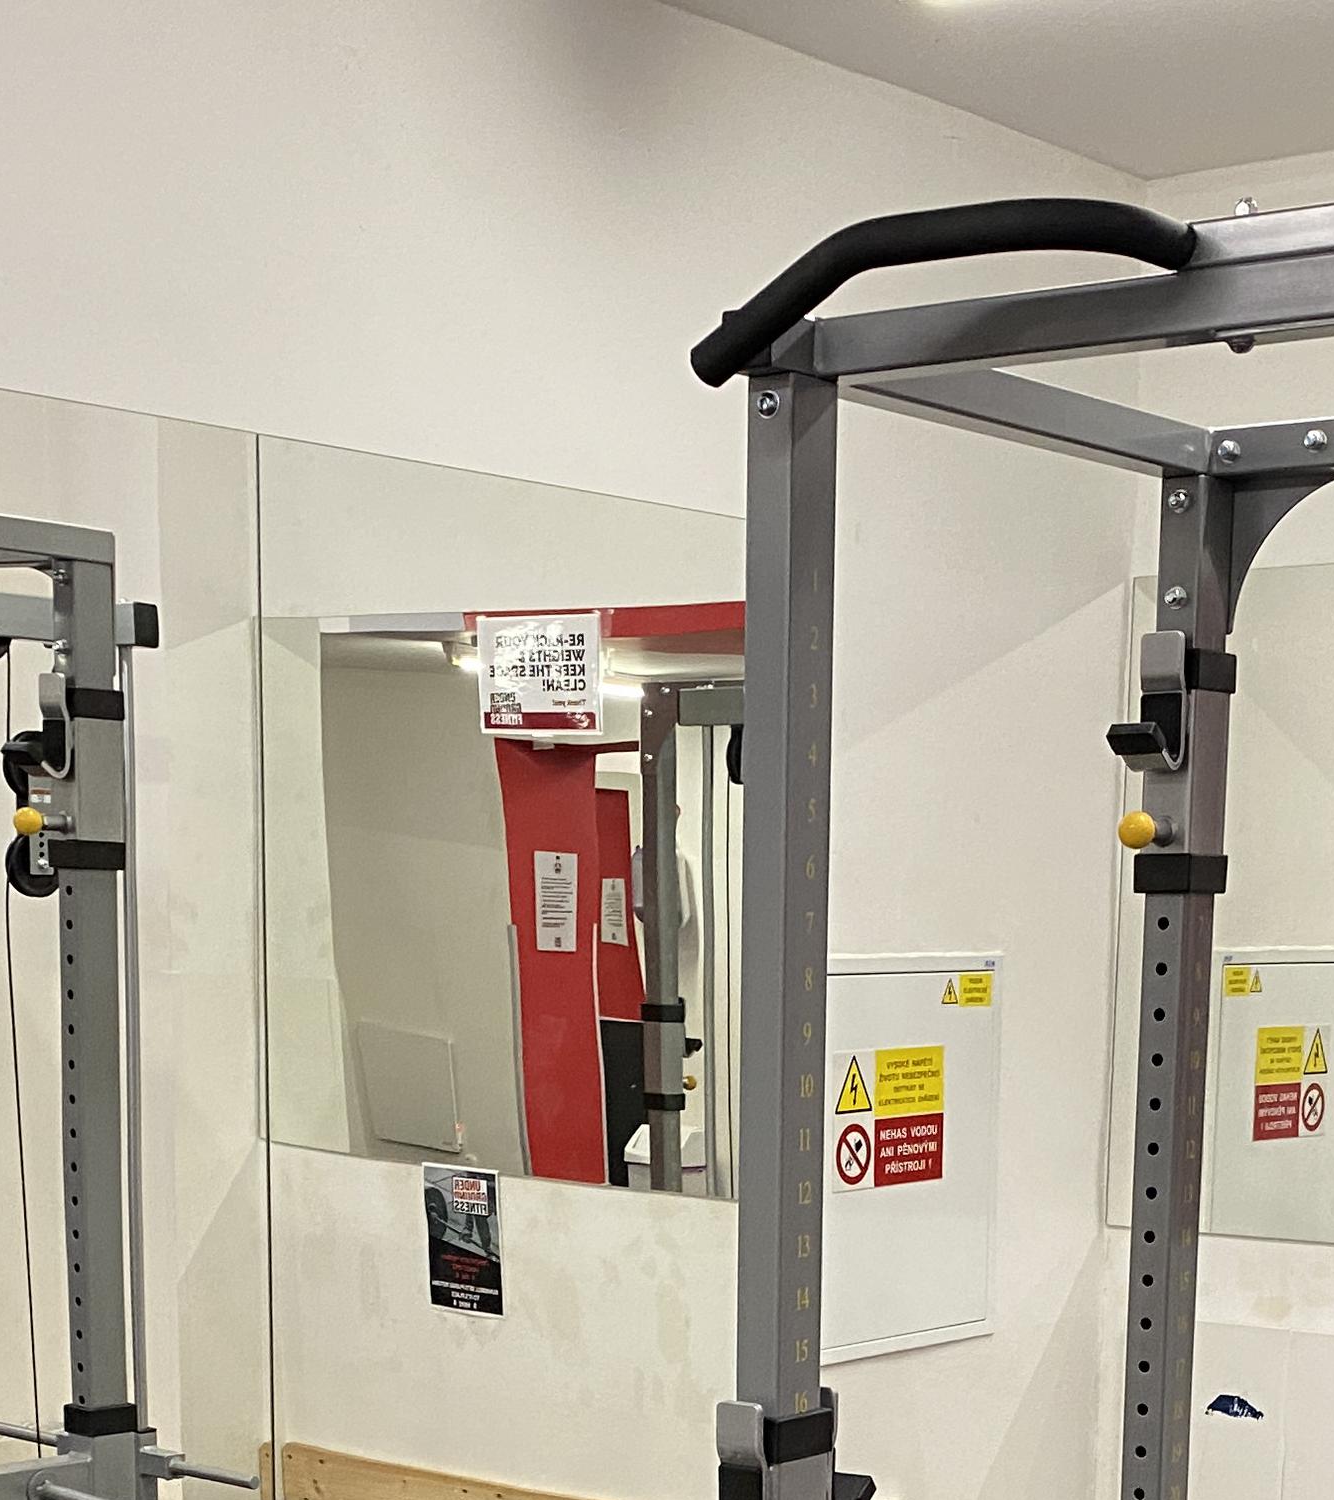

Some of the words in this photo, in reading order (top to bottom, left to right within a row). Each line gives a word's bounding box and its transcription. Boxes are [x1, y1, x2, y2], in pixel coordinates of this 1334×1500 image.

[800, 1073, 814, 1098] 10
[799, 1127, 810, 1152] 11
[880, 1127, 907, 1141] NEHAS
[910, 1124, 938, 1138] VODOU
[880, 1145, 894, 1158] ANI
[798, 1181, 811, 1205] 12
[797, 1234, 810, 1258] 13
[796, 1286, 809, 1310] 14
[795, 1339, 808, 1363] 15
[795, 1390, 807, 1414] 16
